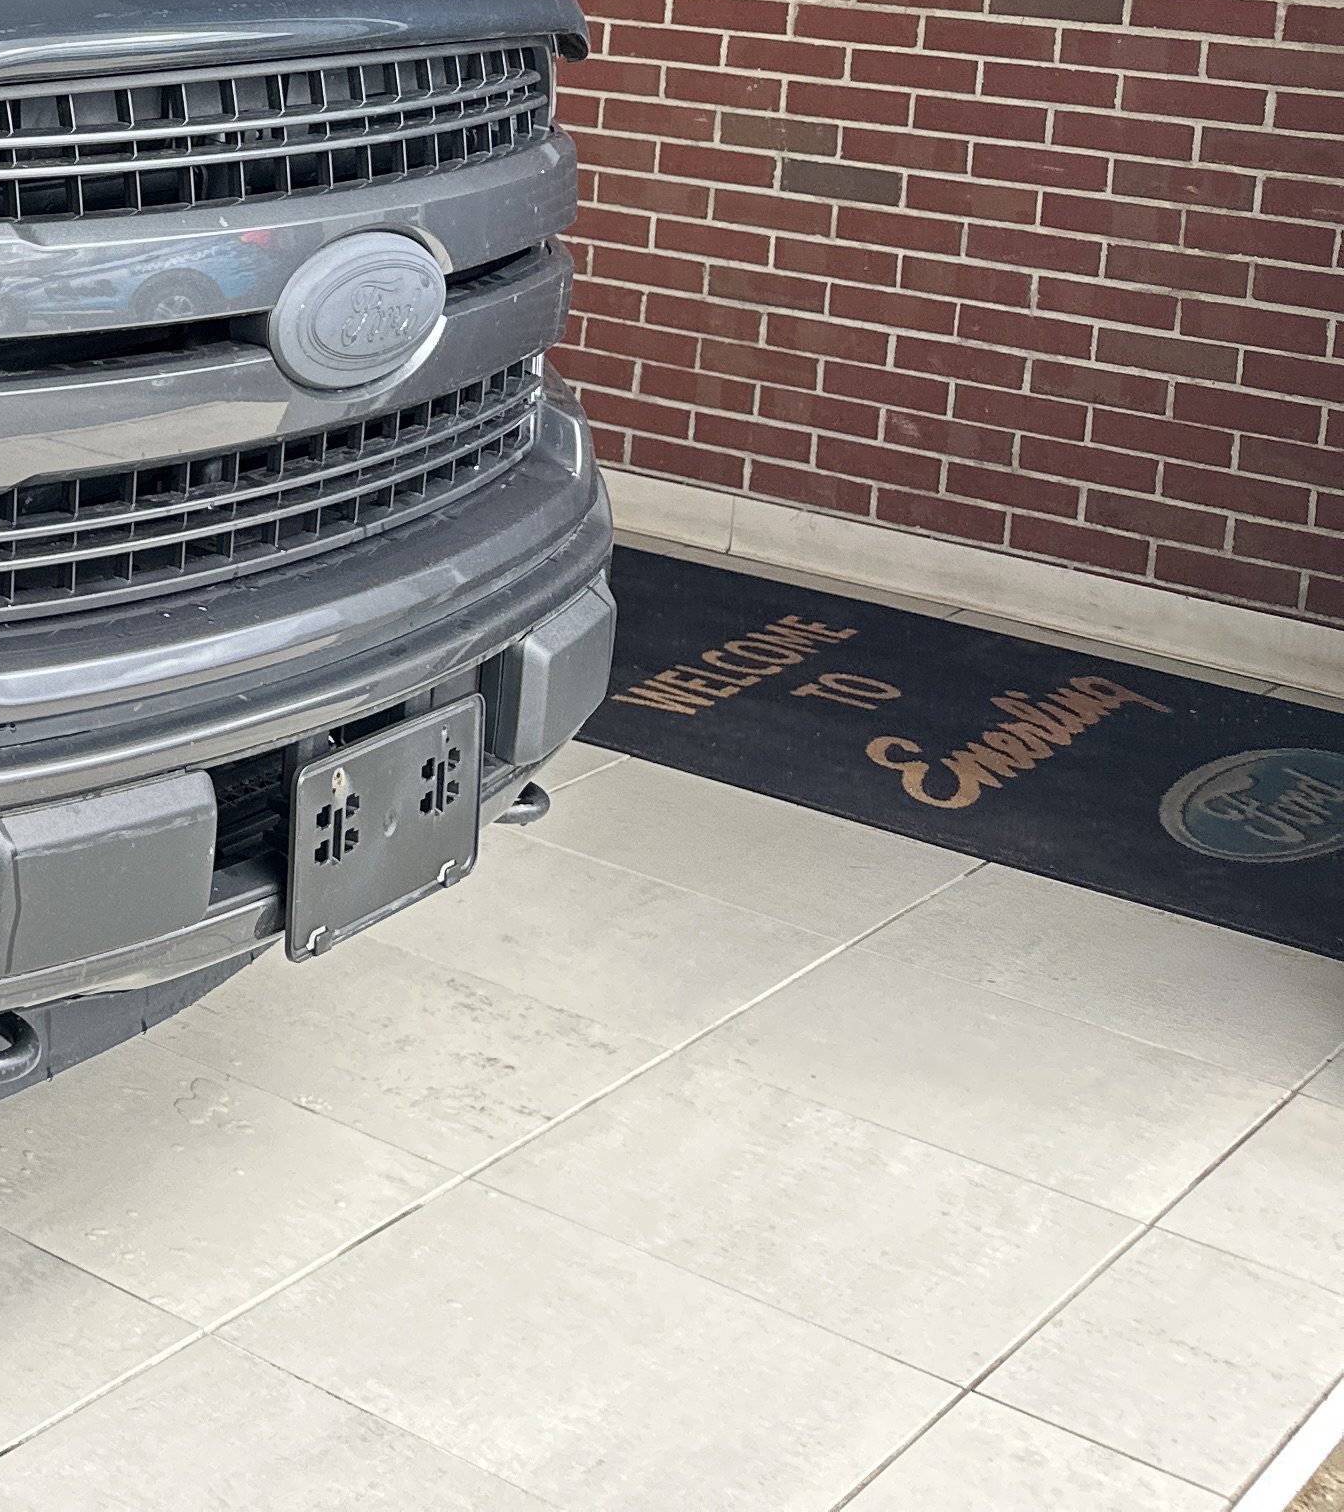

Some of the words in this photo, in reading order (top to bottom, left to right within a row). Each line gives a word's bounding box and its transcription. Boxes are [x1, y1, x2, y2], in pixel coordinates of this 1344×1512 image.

[611, 614, 860, 716] WELCOME
[790, 672, 902, 710] TO
[865, 675, 1173, 810] Emerling
